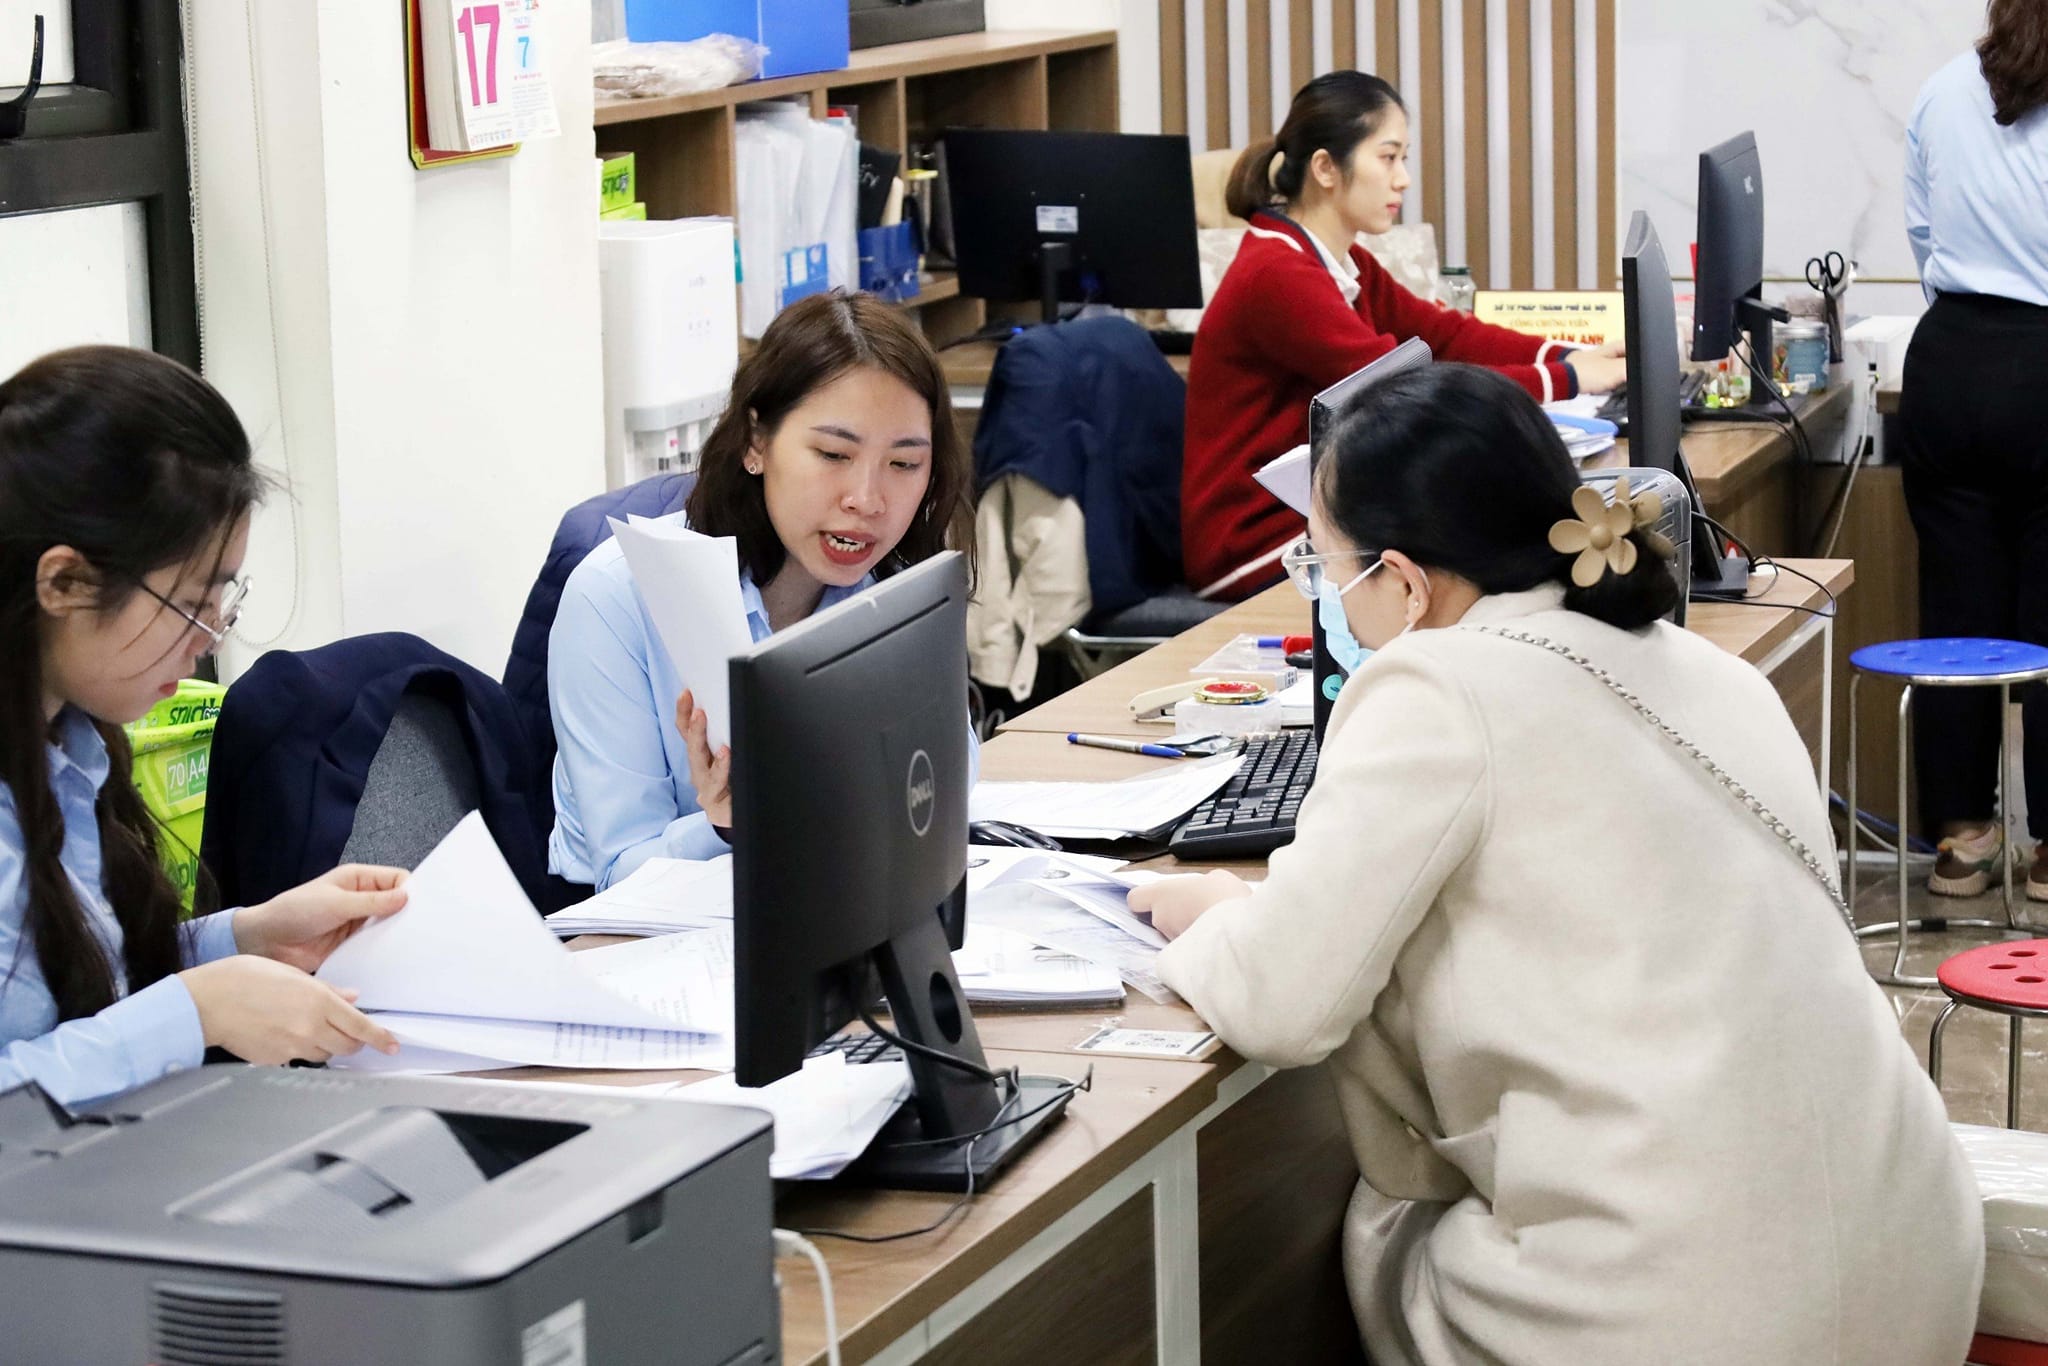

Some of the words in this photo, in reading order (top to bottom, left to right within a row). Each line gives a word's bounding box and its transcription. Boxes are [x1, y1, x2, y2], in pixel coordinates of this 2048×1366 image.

[457, 4, 500, 107] 17
[518, 36, 530, 68] 7
[1579, 334, 1604, 345] ANH
[168, 762, 185, 790] 70
[189, 753, 207, 783] A4
[911, 779, 932, 808] DELL
